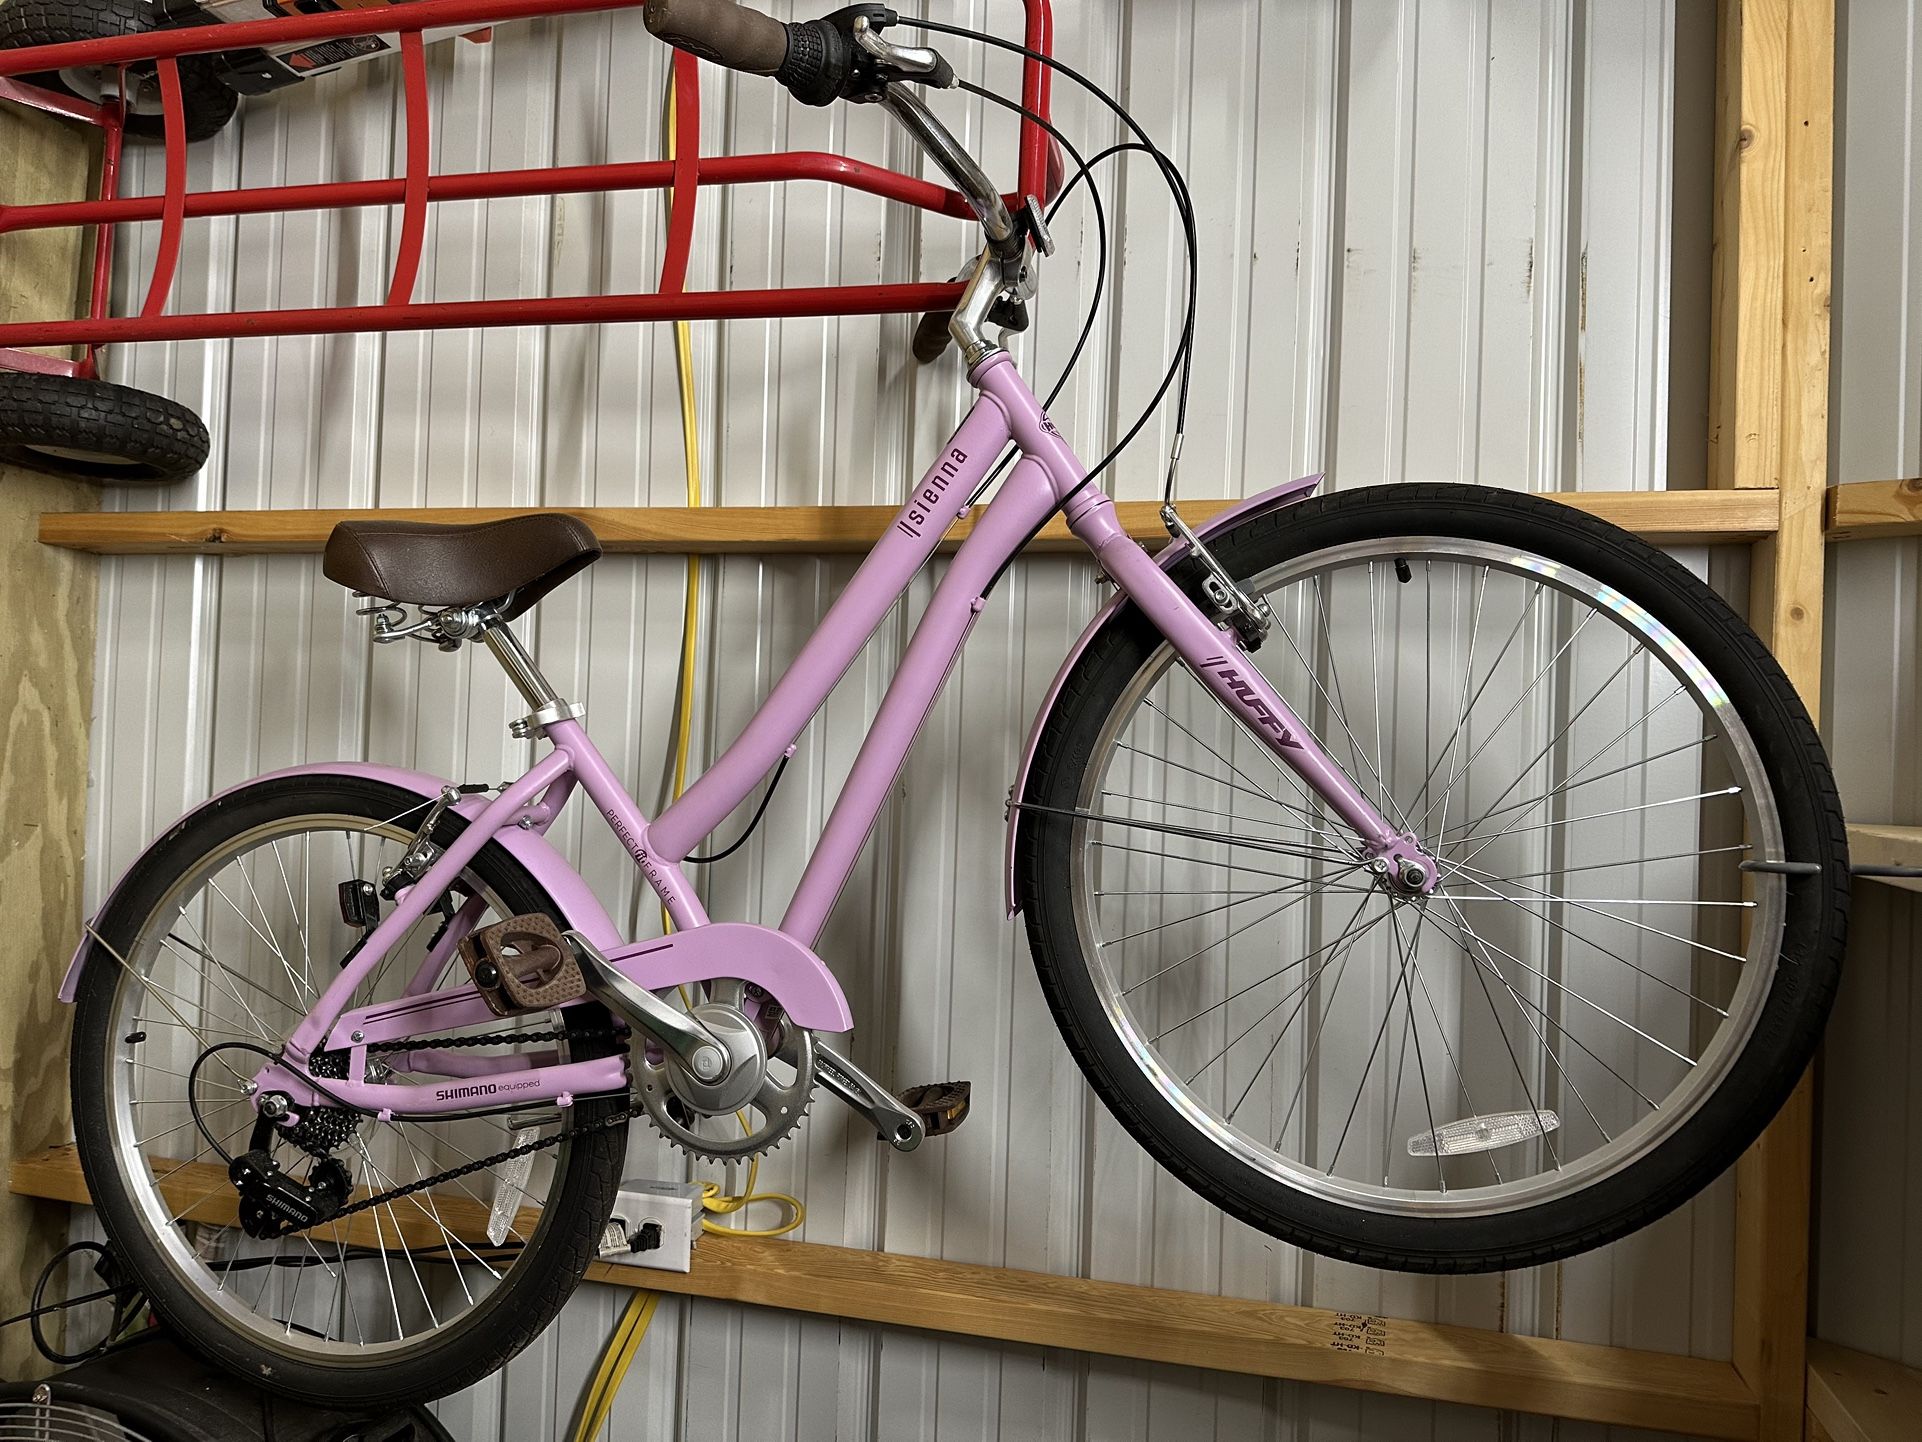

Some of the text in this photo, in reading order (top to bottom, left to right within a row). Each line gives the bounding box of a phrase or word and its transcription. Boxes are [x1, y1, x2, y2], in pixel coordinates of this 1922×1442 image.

[909, 448, 968, 525] sienna
[1218, 669, 1304, 749] HUFFY
[607, 809, 638, 850] PERFECT
[644, 862, 676, 904] FRAME
[436, 1080, 540, 1101] SHIMANO equipped
[266, 1194, 308, 1222] SHIMANO
